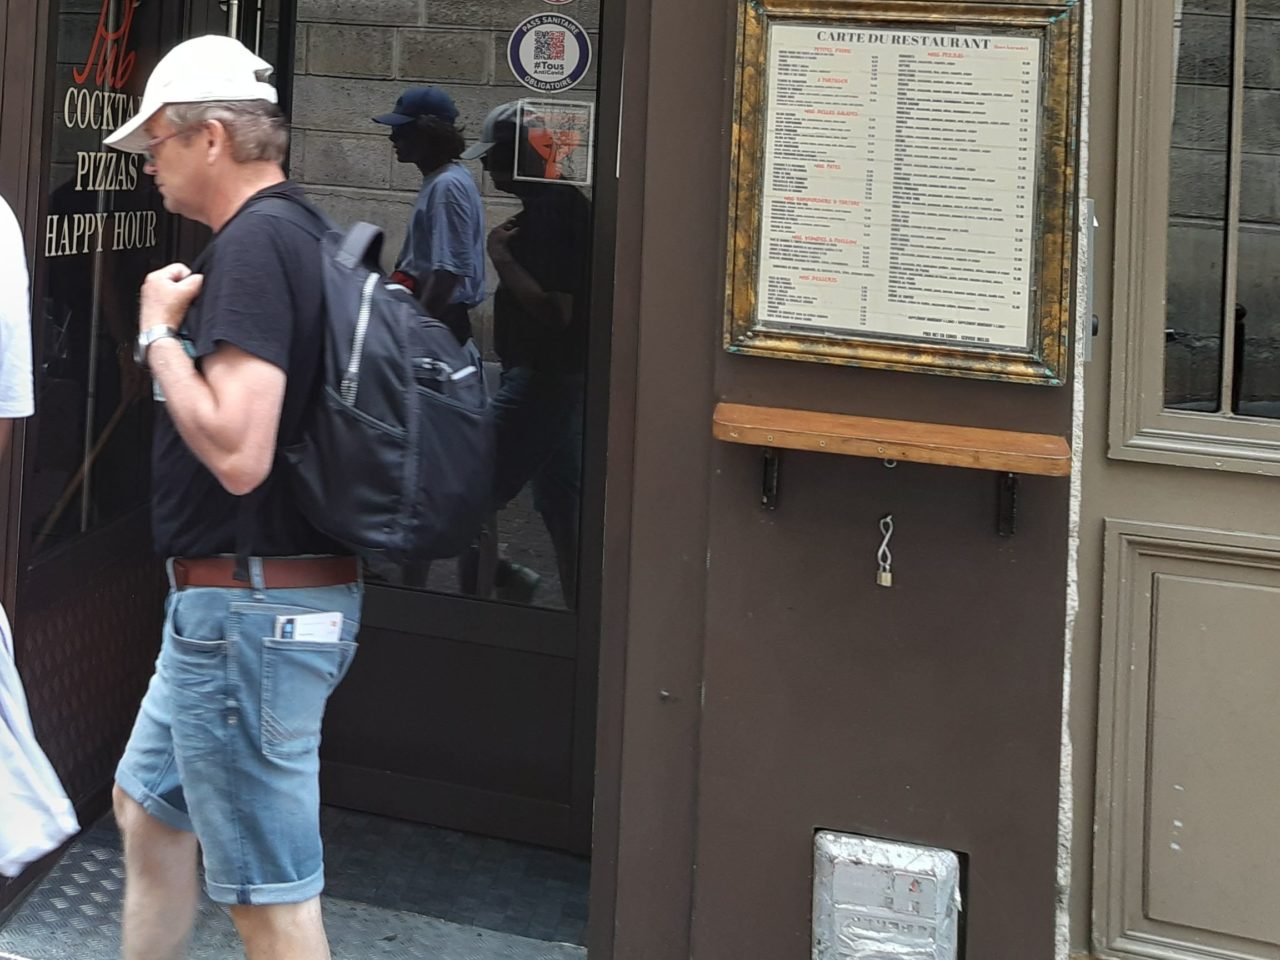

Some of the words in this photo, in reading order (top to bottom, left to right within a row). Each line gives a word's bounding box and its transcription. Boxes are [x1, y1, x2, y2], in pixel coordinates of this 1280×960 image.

[522, 17, 541, 32] PASS
[542, 16, 580, 36] SANITAIRE
[817, 30, 866, 43] CARTE
[868, 33, 889, 45] DU
[891, 34, 992, 50] RESTAURANT
[533, 60, 564, 71] #Tous
[524, 75, 573, 90] OBLIGATOIRE
[64, 86, 144, 131] COCKTA
[74, 150, 139, 192] PIZZAS
[44, 211, 108, 257] HAPPY
[111, 210, 158, 251] HOUR
